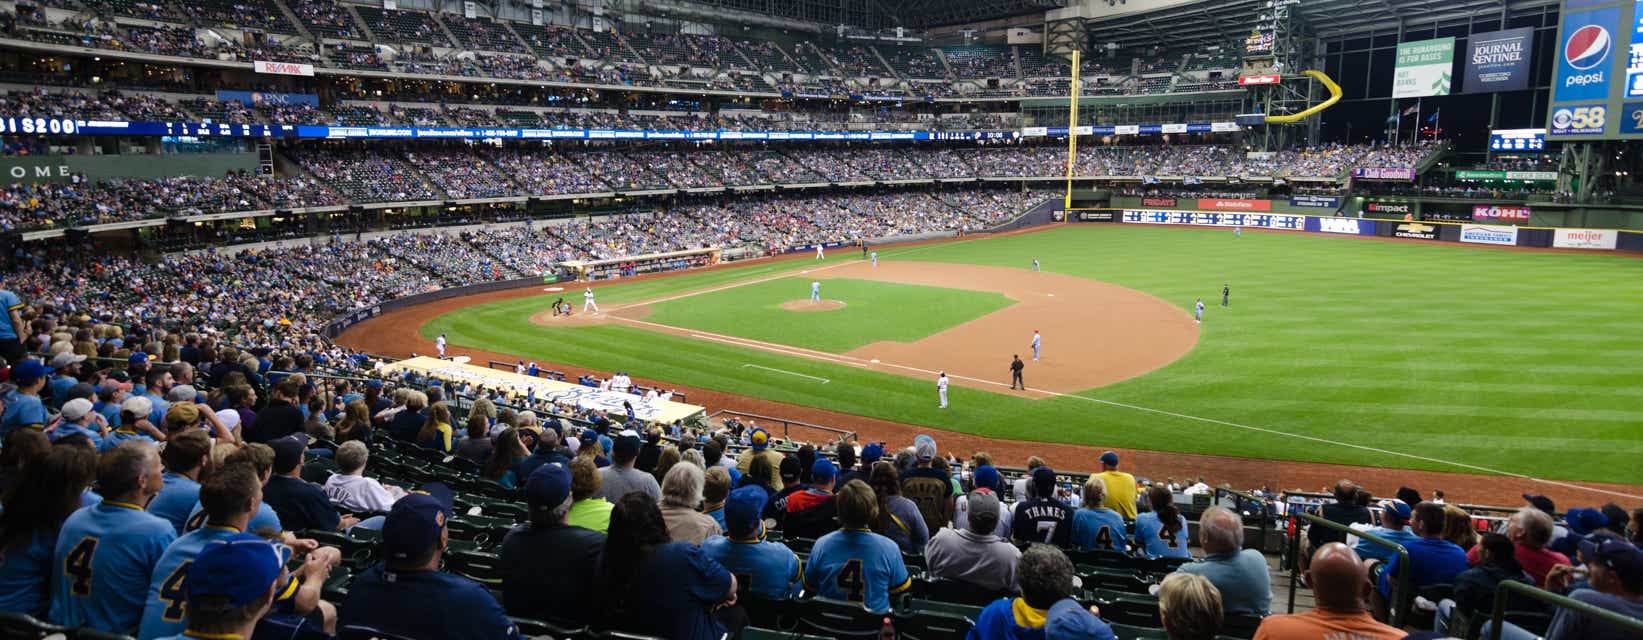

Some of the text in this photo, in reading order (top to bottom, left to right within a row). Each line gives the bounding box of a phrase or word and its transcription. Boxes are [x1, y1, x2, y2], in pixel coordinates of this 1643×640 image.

[1472, 53, 1522, 65] SENTINEL
[1474, 43, 1523, 56] JOURNAL
[1566, 71, 1604, 87] pepsi
[264, 93, 289, 104] PNC
[1571, 106, 1606, 128] 58
[1375, 203, 1409, 213] impact
[1567, 231, 1602, 243] meijer
[1024, 506, 1066, 520] THAMES
[1036, 521, 1058, 543] 7
[1095, 525, 1114, 550] 4
[1157, 522, 1180, 549] 4
[64, 535, 99, 597] 4
[159, 559, 193, 622] 4
[836, 558, 865, 604] 4
